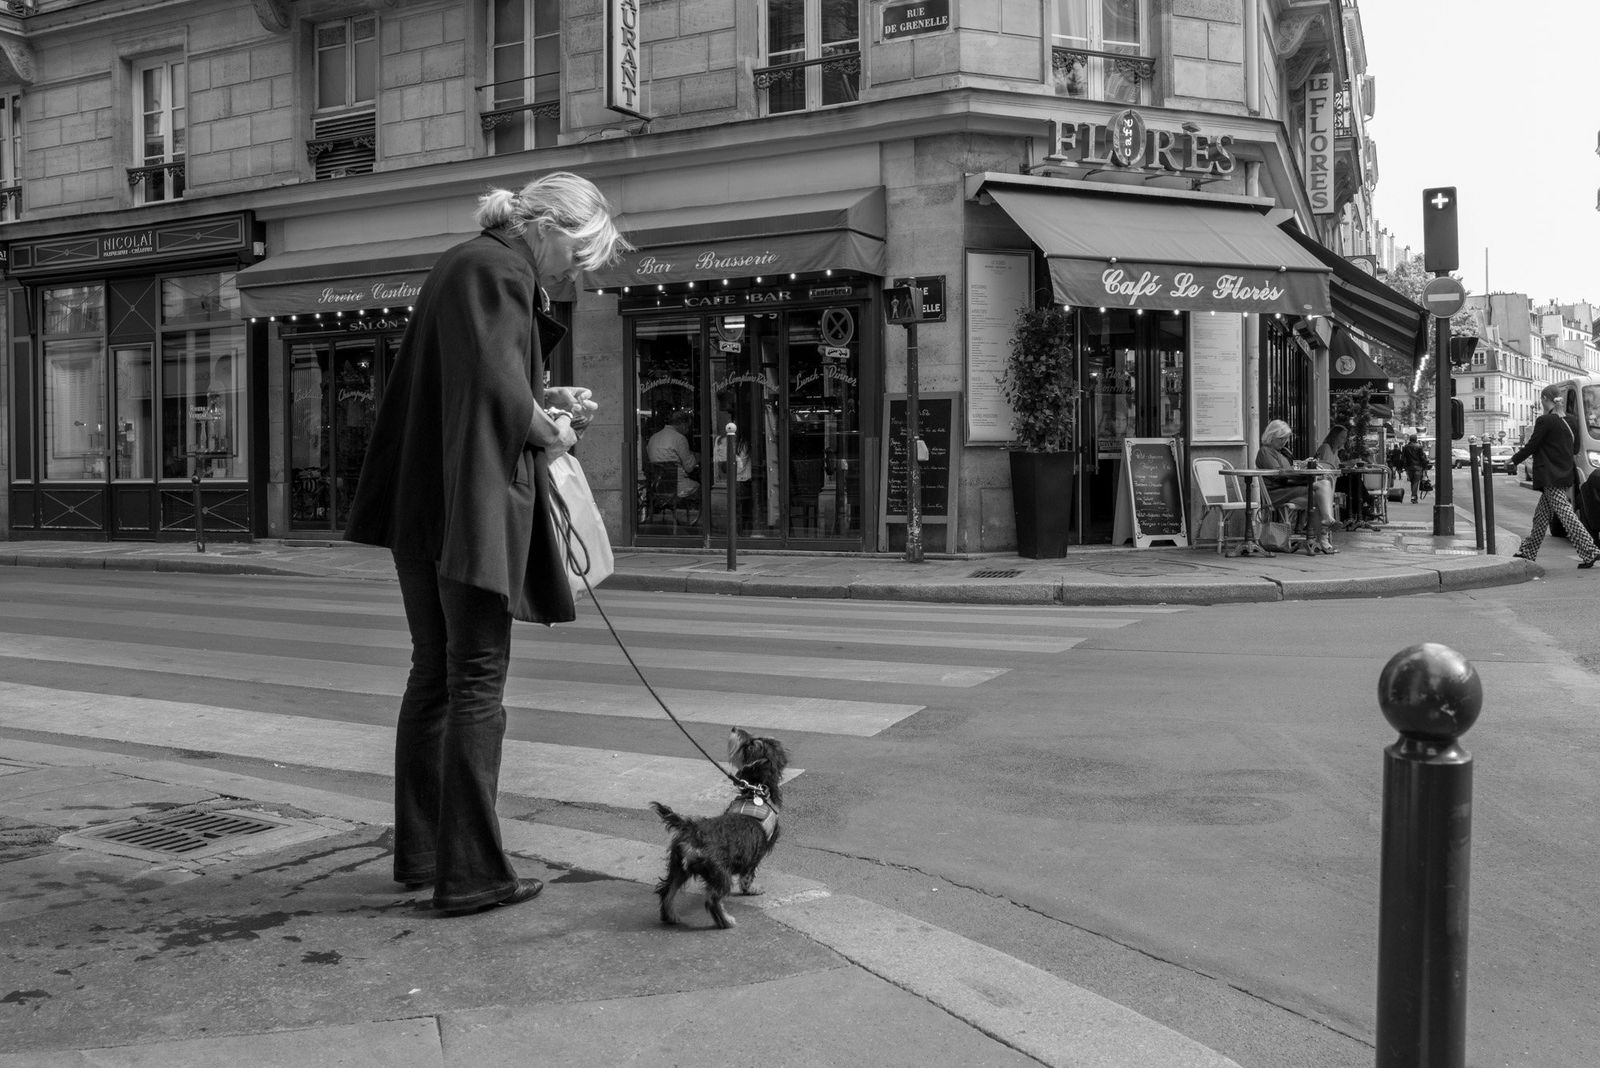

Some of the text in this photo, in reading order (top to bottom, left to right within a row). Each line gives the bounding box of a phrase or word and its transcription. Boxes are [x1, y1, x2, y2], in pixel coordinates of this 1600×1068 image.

[907, 7, 925, 18] RUE
[885, 15, 948, 34] DE GRENELLE
[1309, 78, 1329, 92] LE
[1309, 97, 1328, 210] FLORES
[103, 231, 153, 250] NICOLAÏ
[637, 250, 780, 275] Bar Brasserie
[318, 288, 365, 304] Service
[1101, 269, 1285, 306] Café Le Florès
[750, 291, 792, 304] BAR
[349, 320, 398, 331] SALON
[795, 368, 819, 391] Lunch
[829, 365, 857, 387] Dinner
